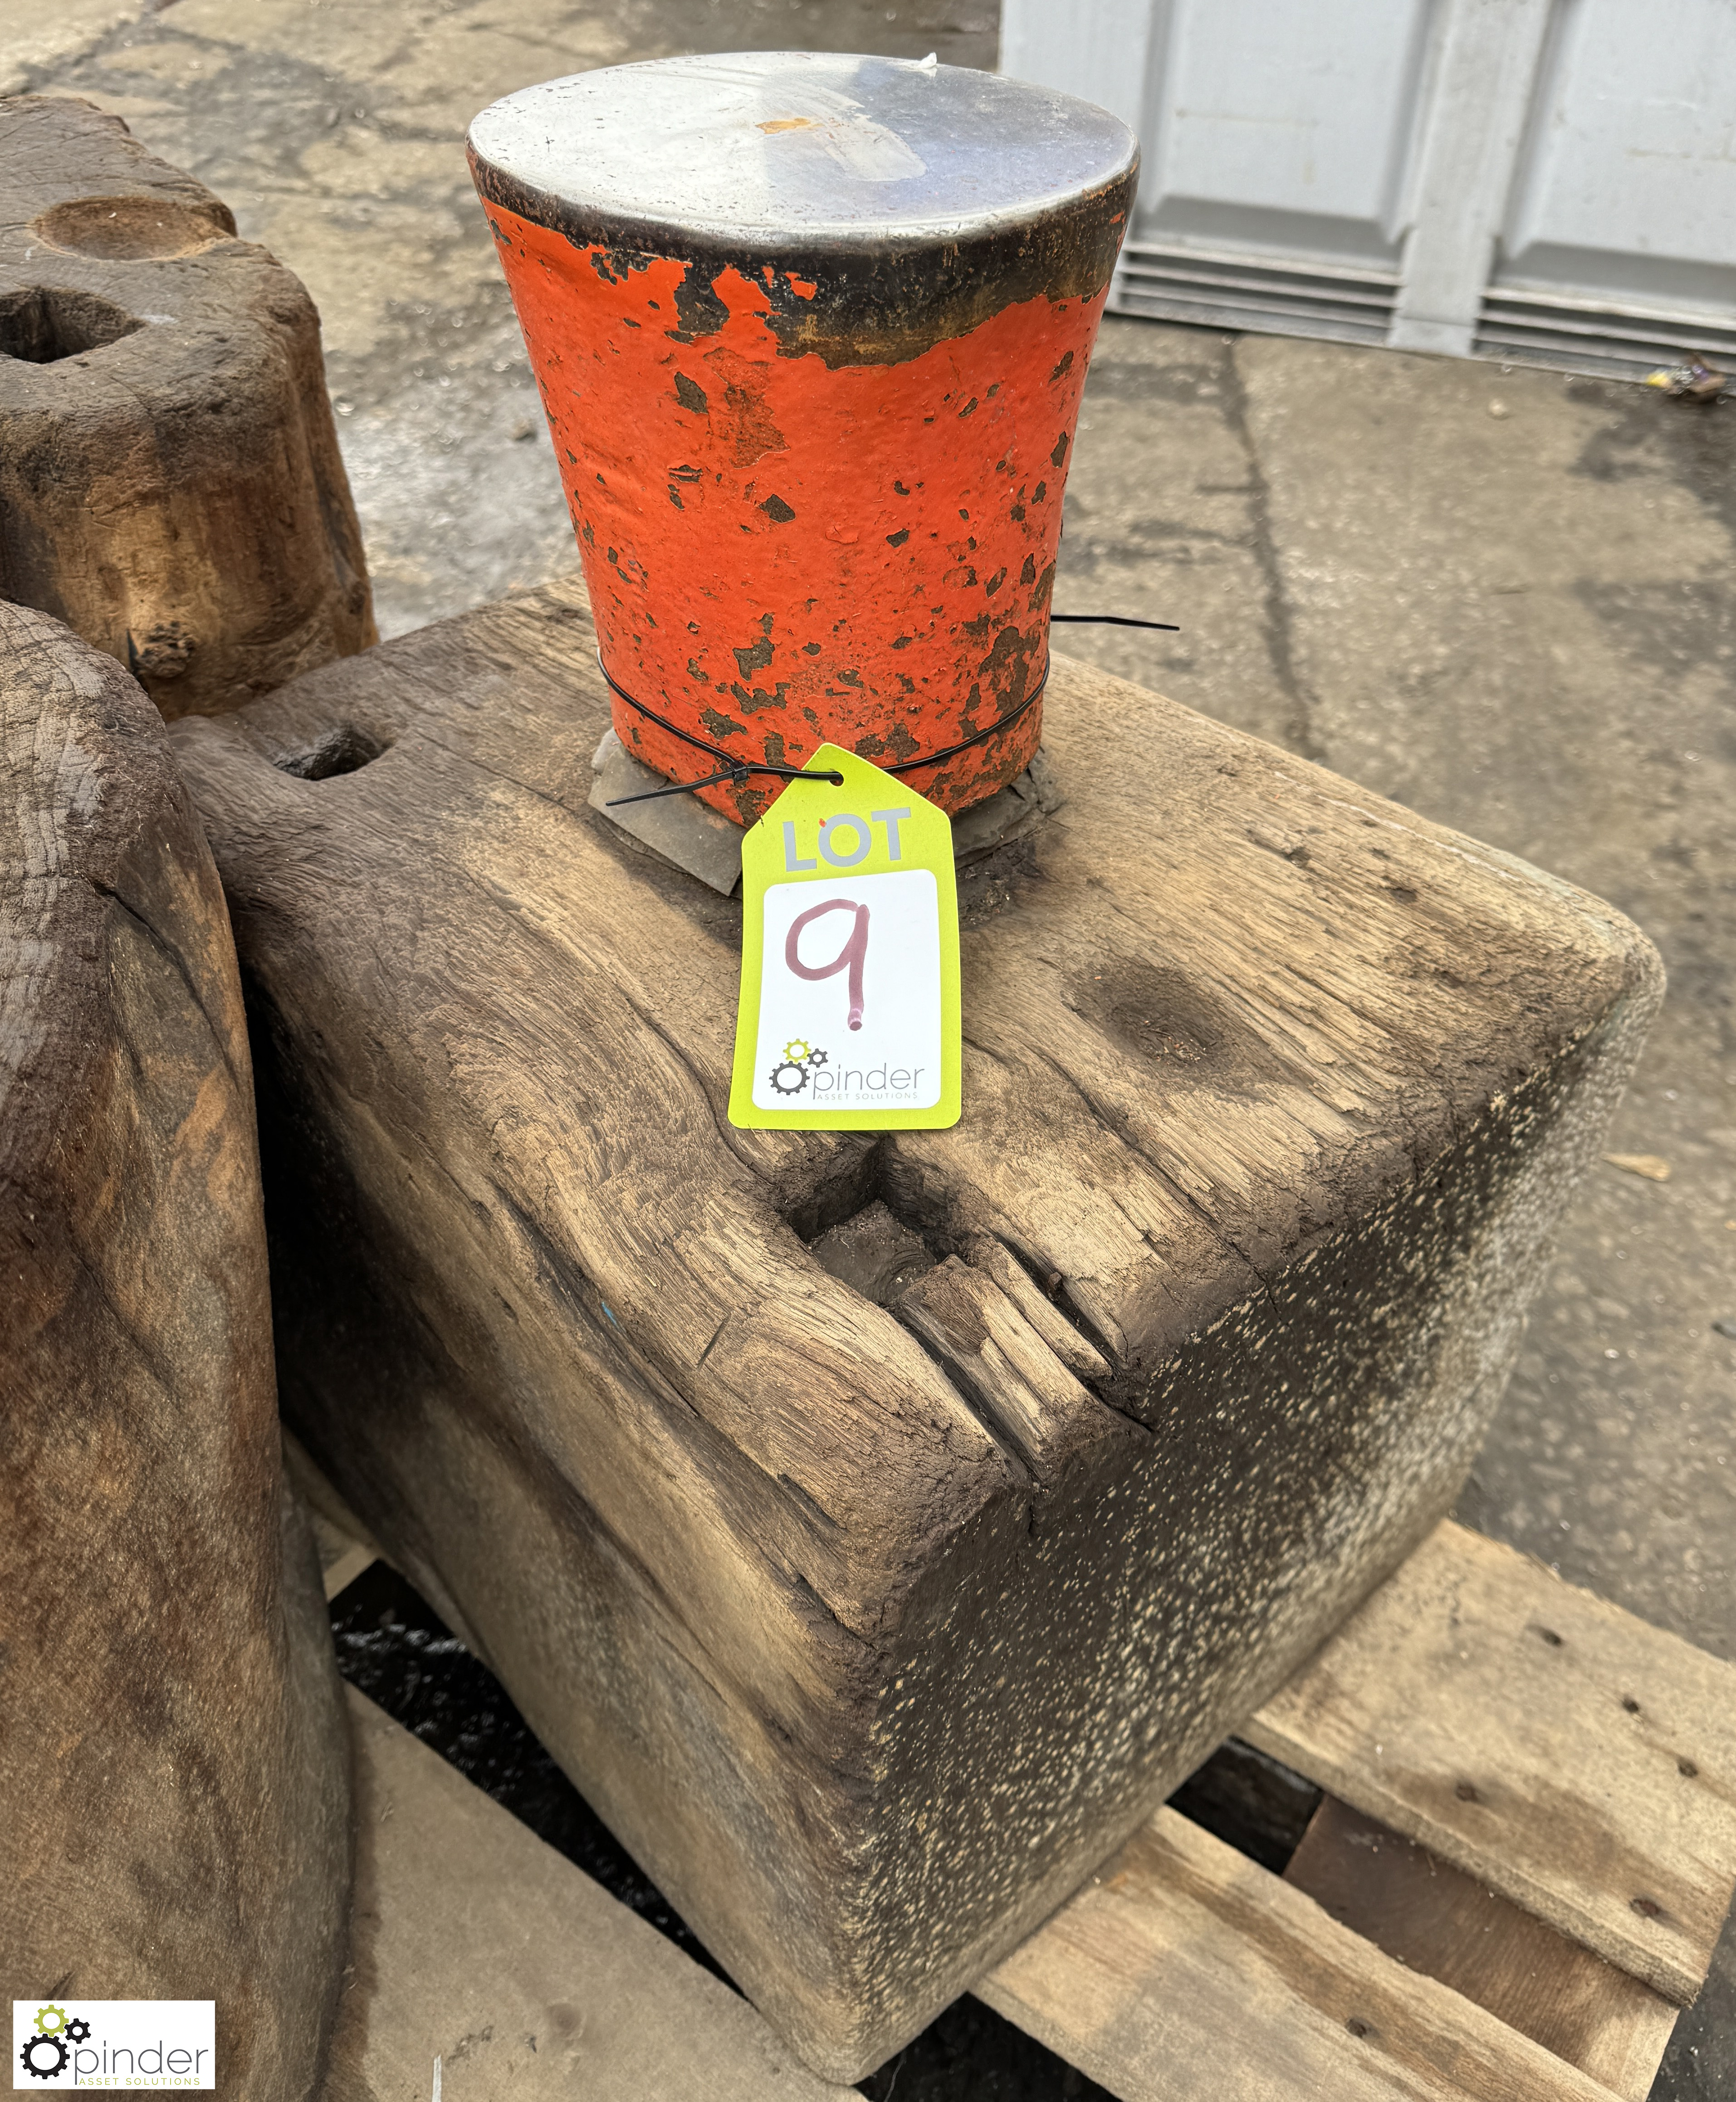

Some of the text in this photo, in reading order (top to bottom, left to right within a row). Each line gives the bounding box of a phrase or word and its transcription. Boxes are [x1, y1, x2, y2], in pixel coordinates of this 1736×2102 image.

[782, 807, 912, 872] LOT
[785, 898, 870, 1031] 9
[813, 1062, 925, 1100] pinder
